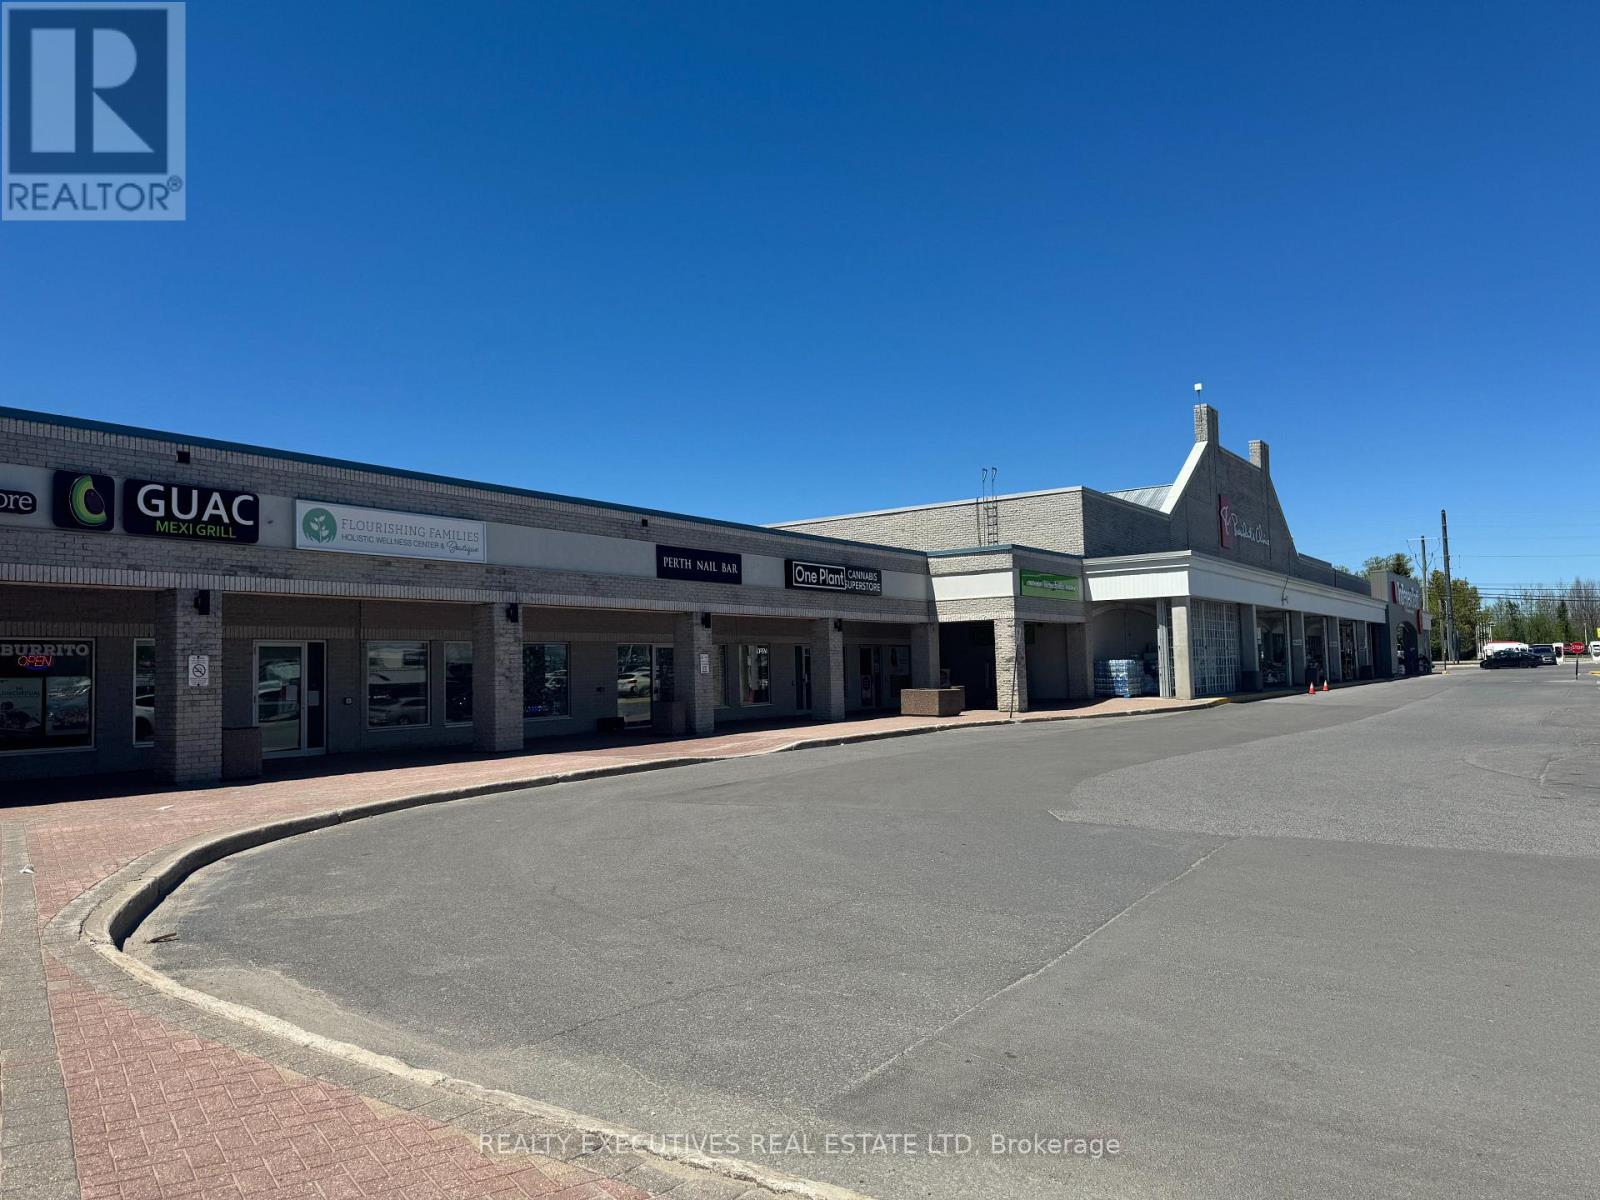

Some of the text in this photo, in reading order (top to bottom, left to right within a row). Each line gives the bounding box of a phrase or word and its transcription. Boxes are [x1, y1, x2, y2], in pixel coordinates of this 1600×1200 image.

[136, 484, 255, 526] GUAC
[155, 520, 237, 539] MEXI GRILL
[341, 518, 480, 543] FLOURISHING FAMILIES
[341, 534, 375, 544] HOLISTIC
[376, 536, 412, 547] WELLNESS
[413, 539, 439, 548] CENTER
[663, 556, 738, 574] PERTH NAIL BAR
[795, 565, 844, 586] One Plant
[847, 570, 878, 582] CANNABIS
[845, 579, 881, 592] SUPERSTORE
[0, 643, 89, 657] BURRITO
[18, 655, 52, 667] OPEN
